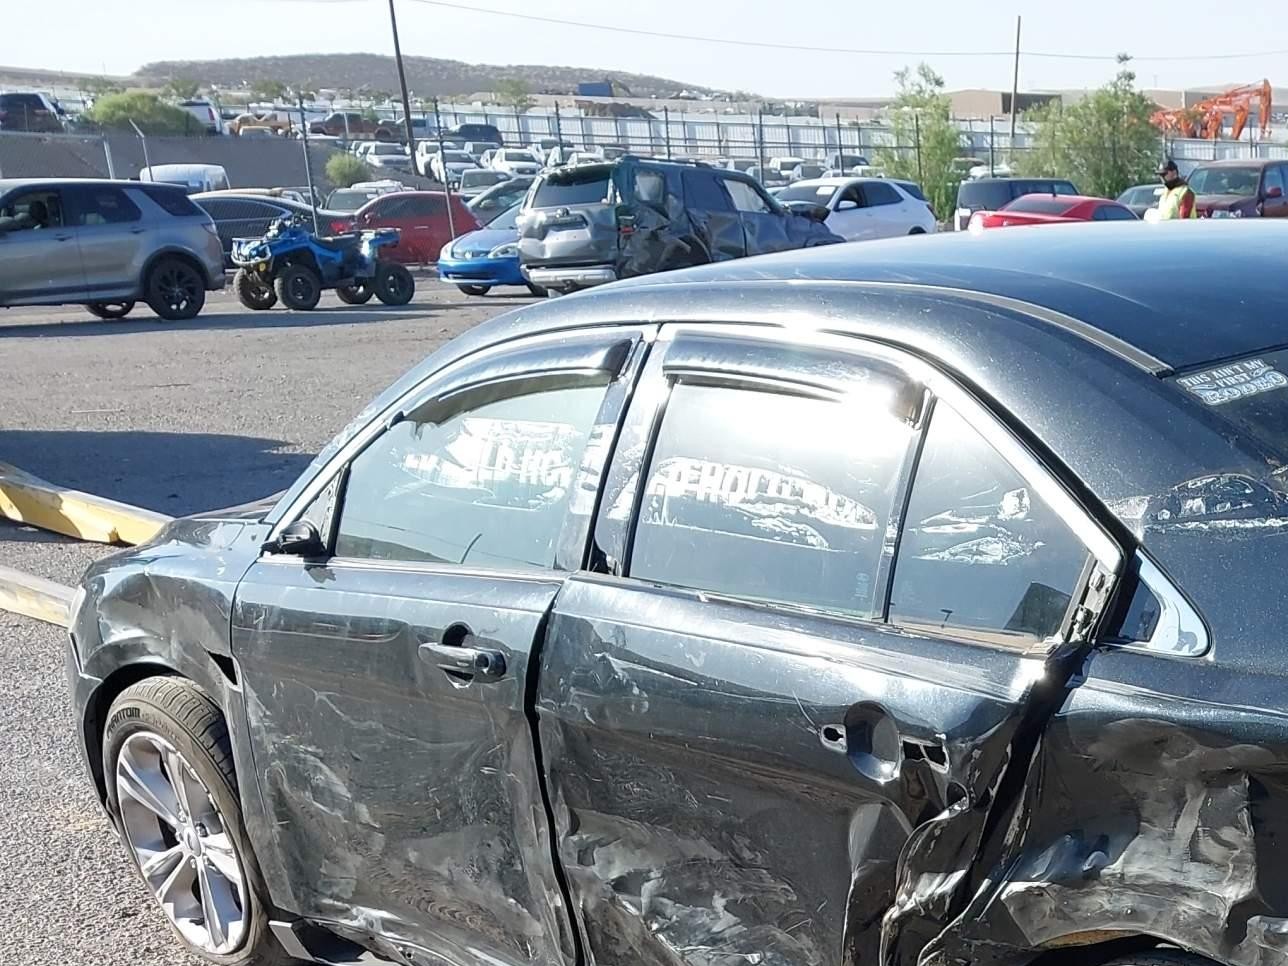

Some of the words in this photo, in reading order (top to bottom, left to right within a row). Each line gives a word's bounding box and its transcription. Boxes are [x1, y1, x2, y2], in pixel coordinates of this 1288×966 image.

[1181, 373, 1211, 388] THIS
[1213, 365, 1244, 379] AIN'T
[1243, 358, 1265, 371] MY
[1215, 372, 1252, 388] FIRST
